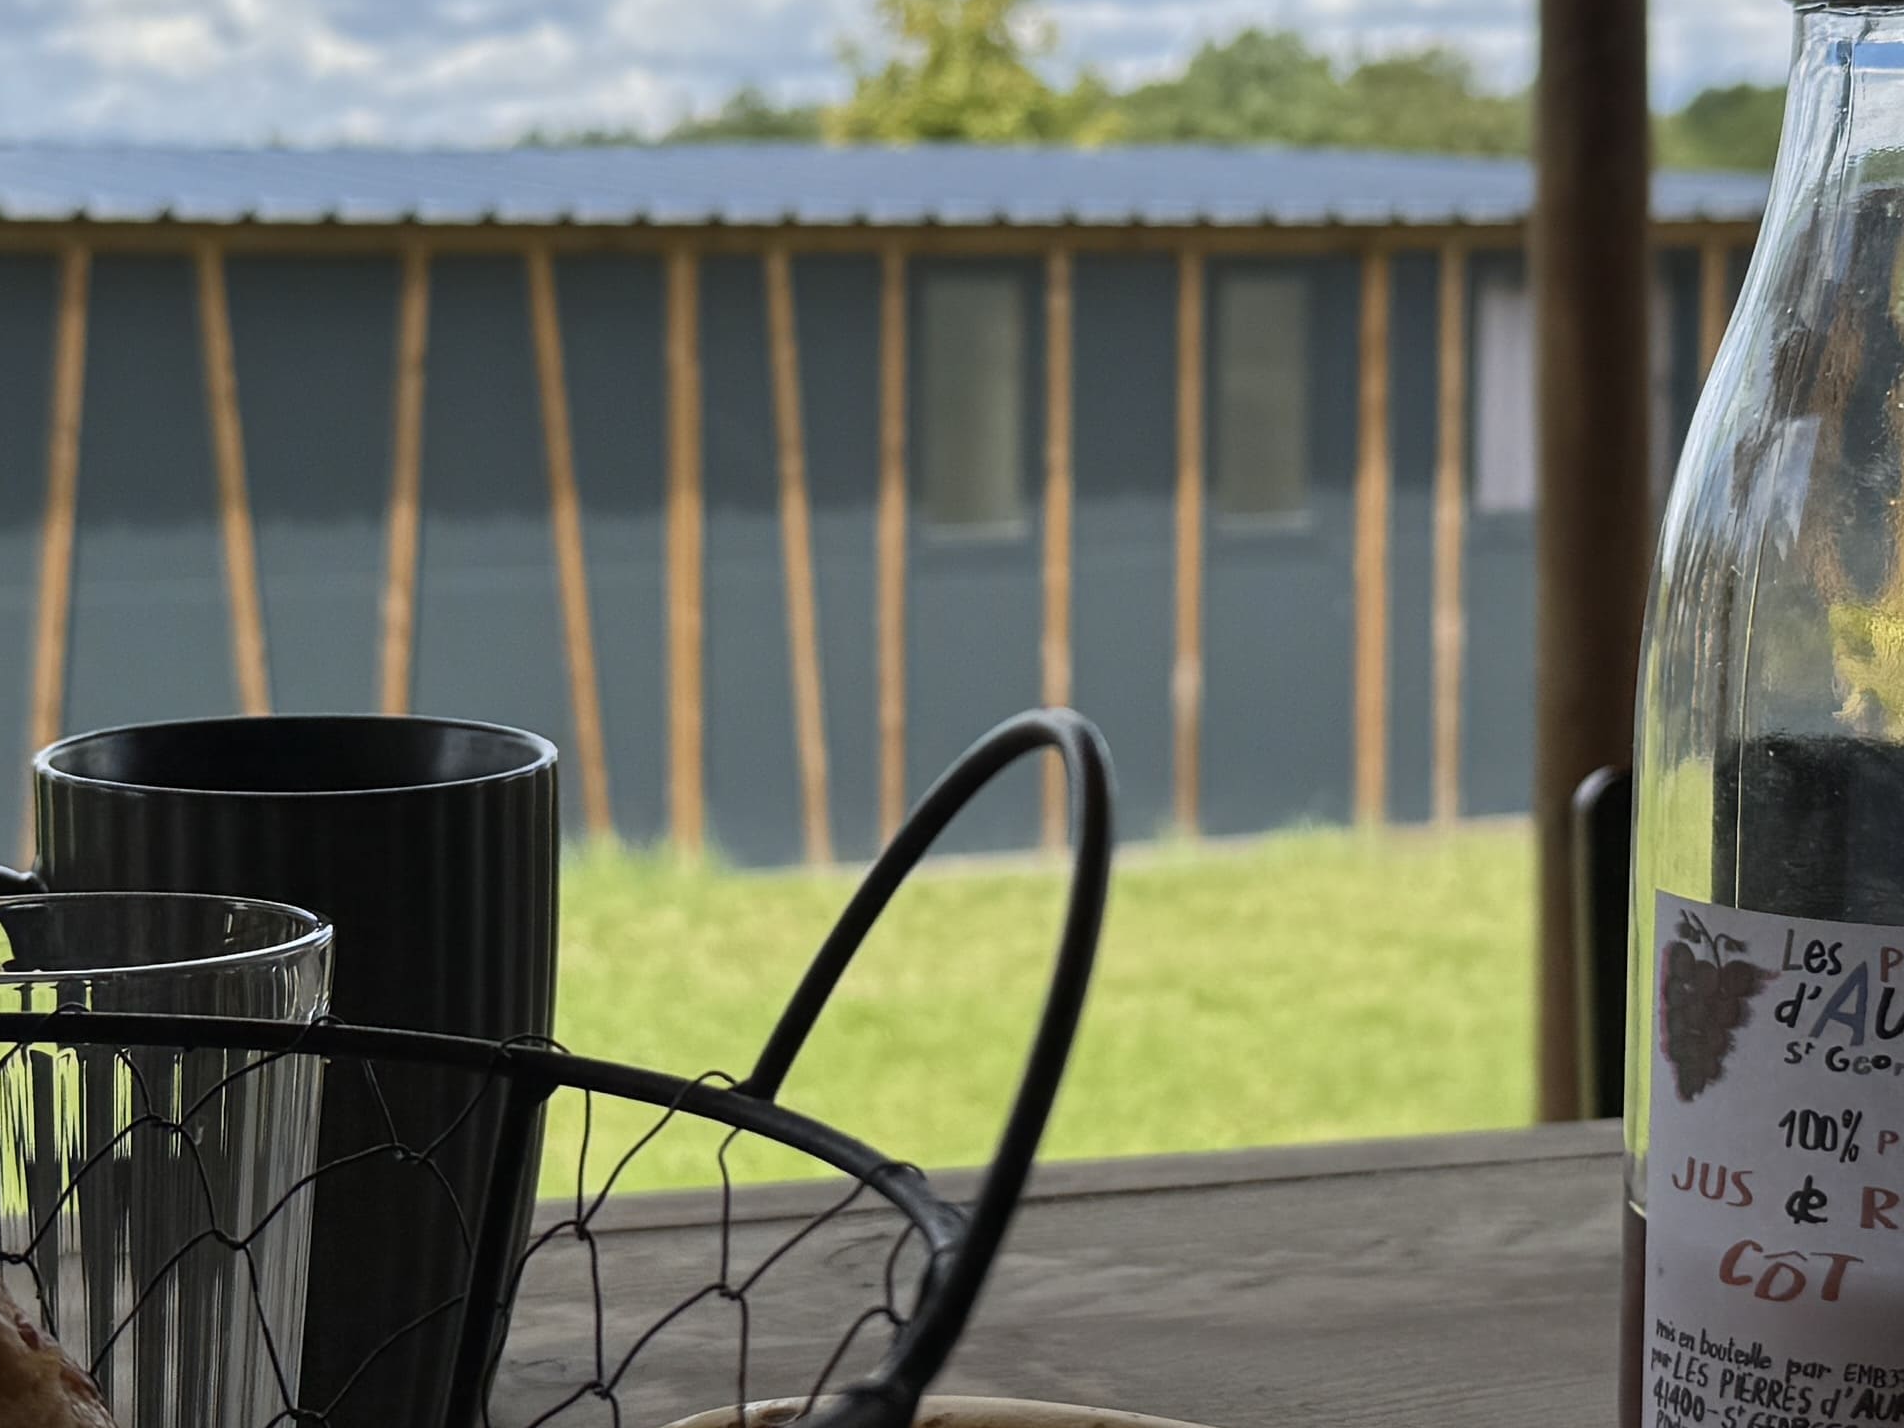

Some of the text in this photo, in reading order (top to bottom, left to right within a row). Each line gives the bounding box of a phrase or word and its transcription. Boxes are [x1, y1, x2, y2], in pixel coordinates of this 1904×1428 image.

[1782, 929, 1842, 975] Les
[1778, 1108, 1863, 1163] 100%
[1672, 1156, 1754, 1208] JUS
[1718, 1239, 1863, 1302] CÔT
[1656, 1318, 1675, 1342] mis
[1679, 1330, 1695, 1352] en
[1699, 1327, 1772, 1370] bouteille
[1786, 1358, 1832, 1385] par
[1673, 1352, 1709, 1388] LES
